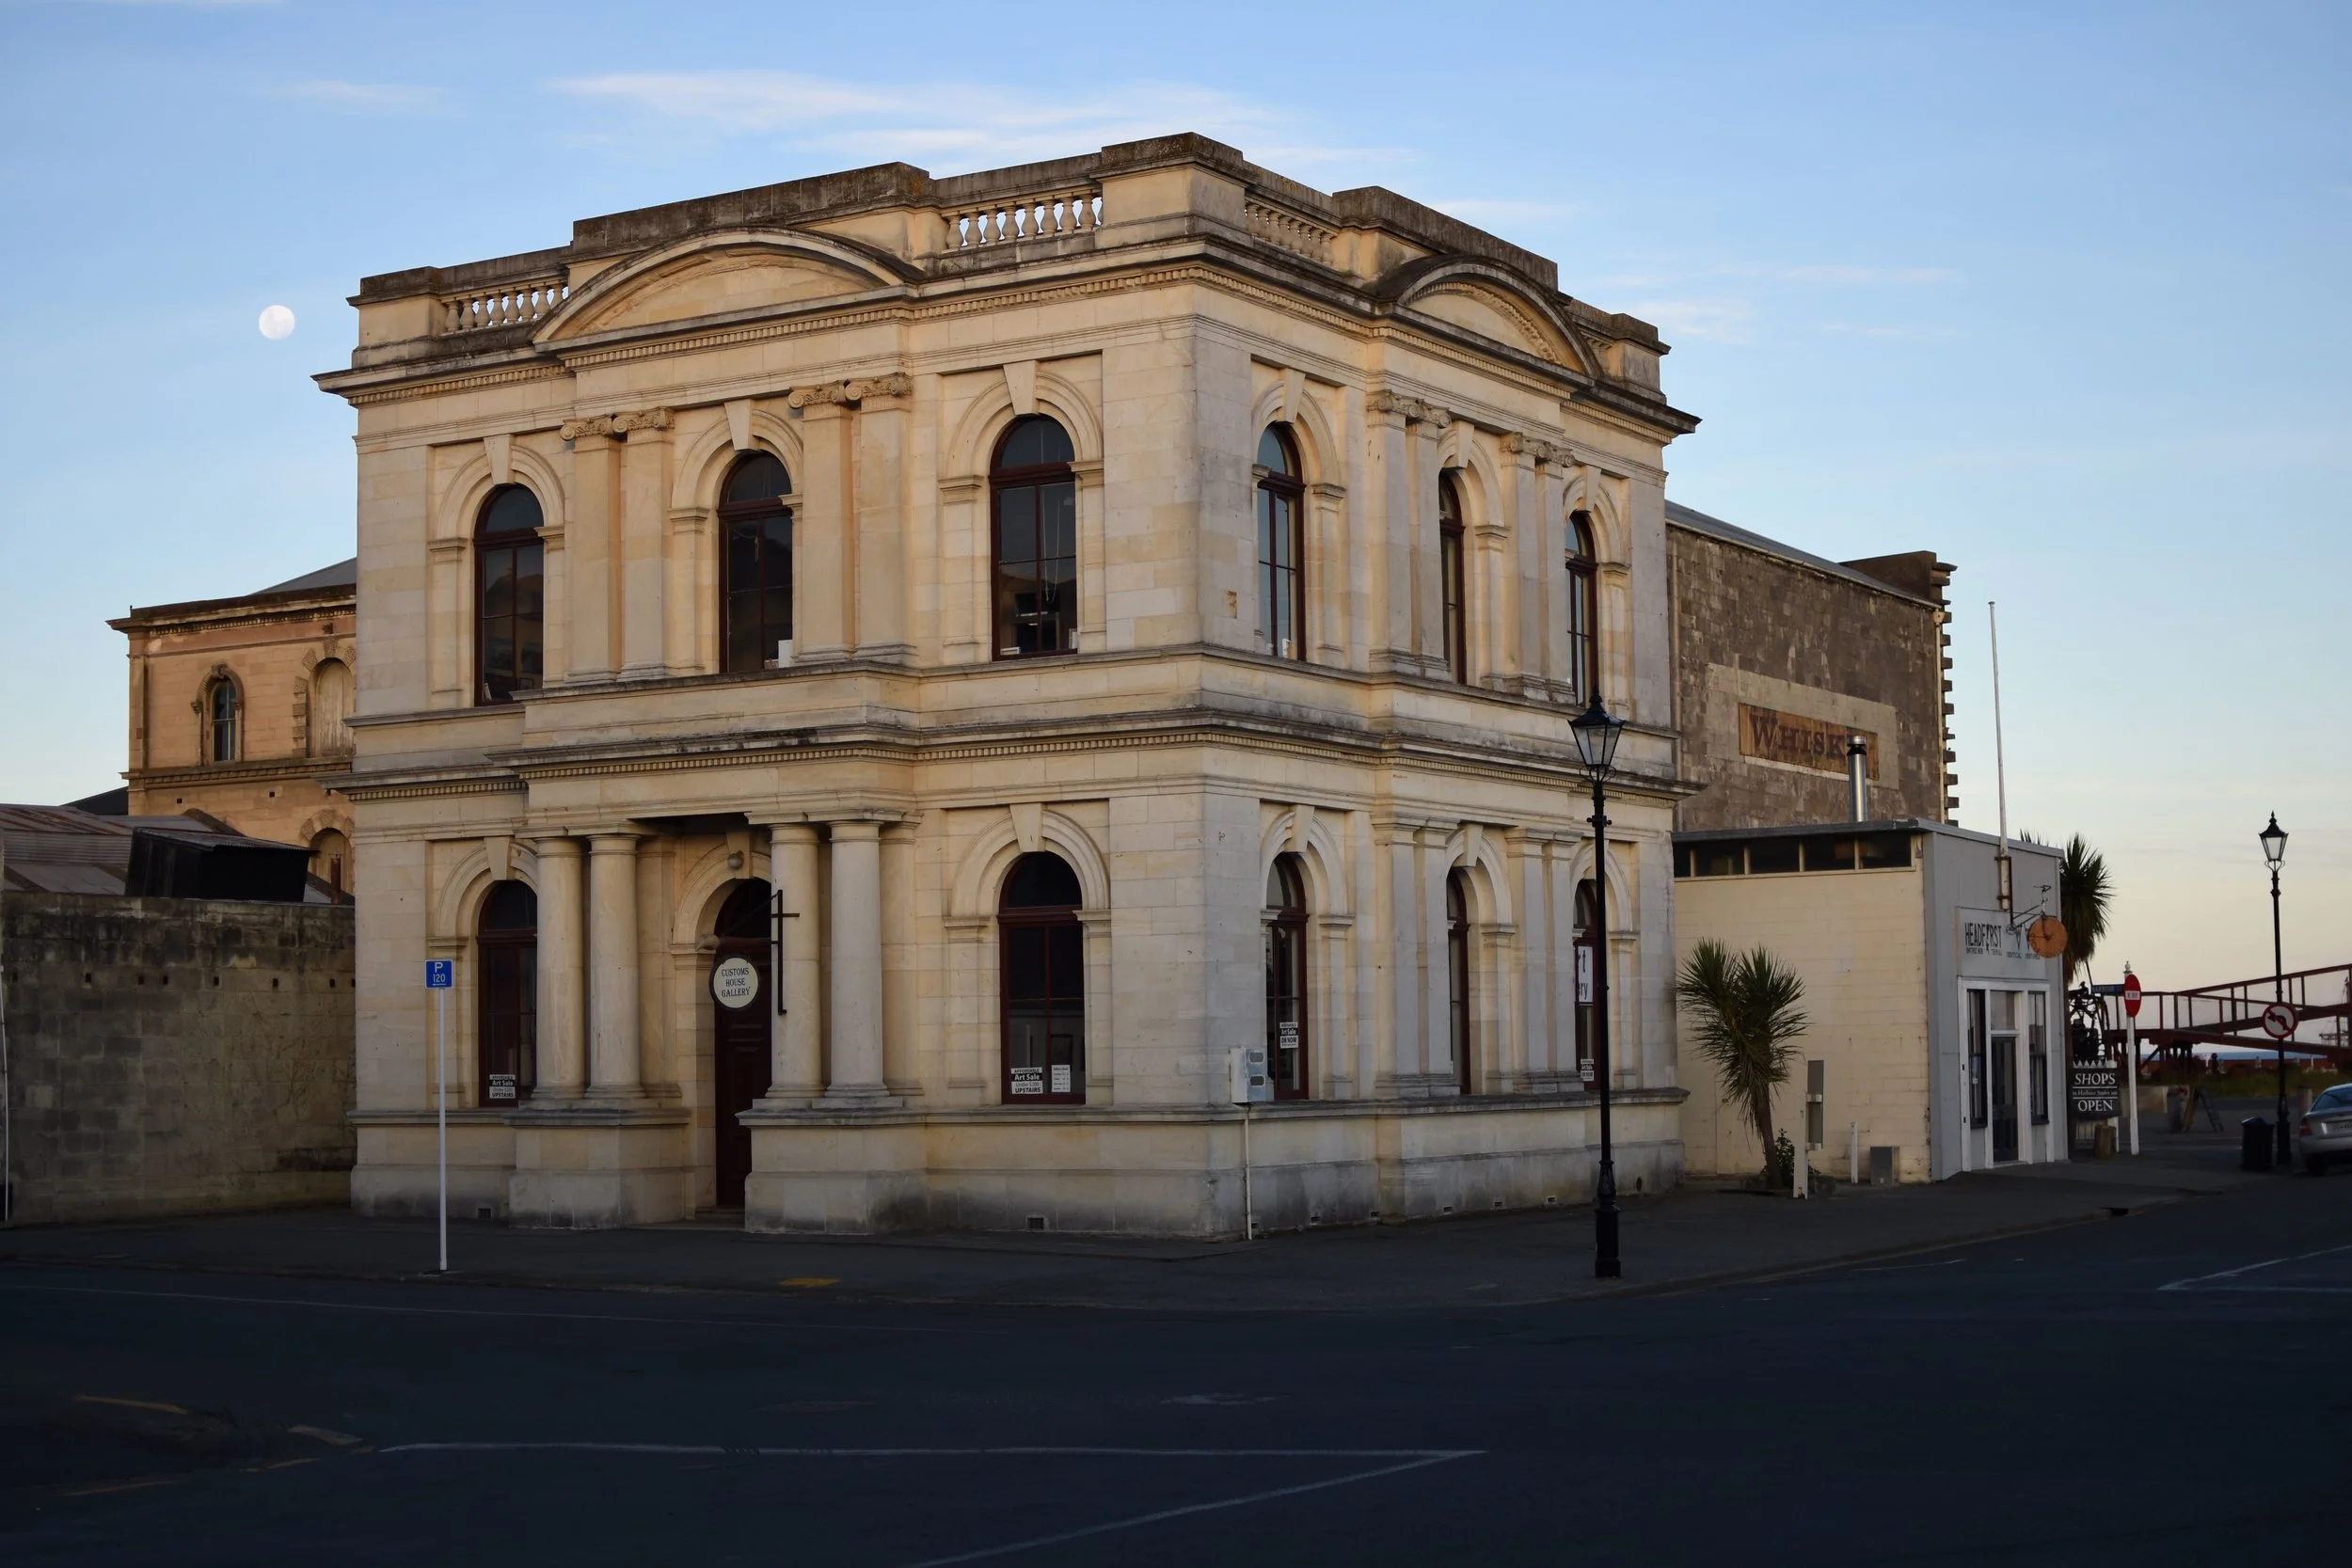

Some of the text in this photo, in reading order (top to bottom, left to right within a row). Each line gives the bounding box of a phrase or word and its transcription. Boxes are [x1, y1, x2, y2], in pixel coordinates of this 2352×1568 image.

[1751, 713, 1847, 761] WHISK
[435, 961, 443, 974] P
[721, 967, 750, 977] CUSTOMS
[433, 974, 446, 983] 120
[725, 978, 746, 987] HOUSE
[721, 987, 751, 998] GALLERY
[2074, 1072, 2116, 1085] SHOPS
[2077, 1100, 2113, 1112] OPEN
